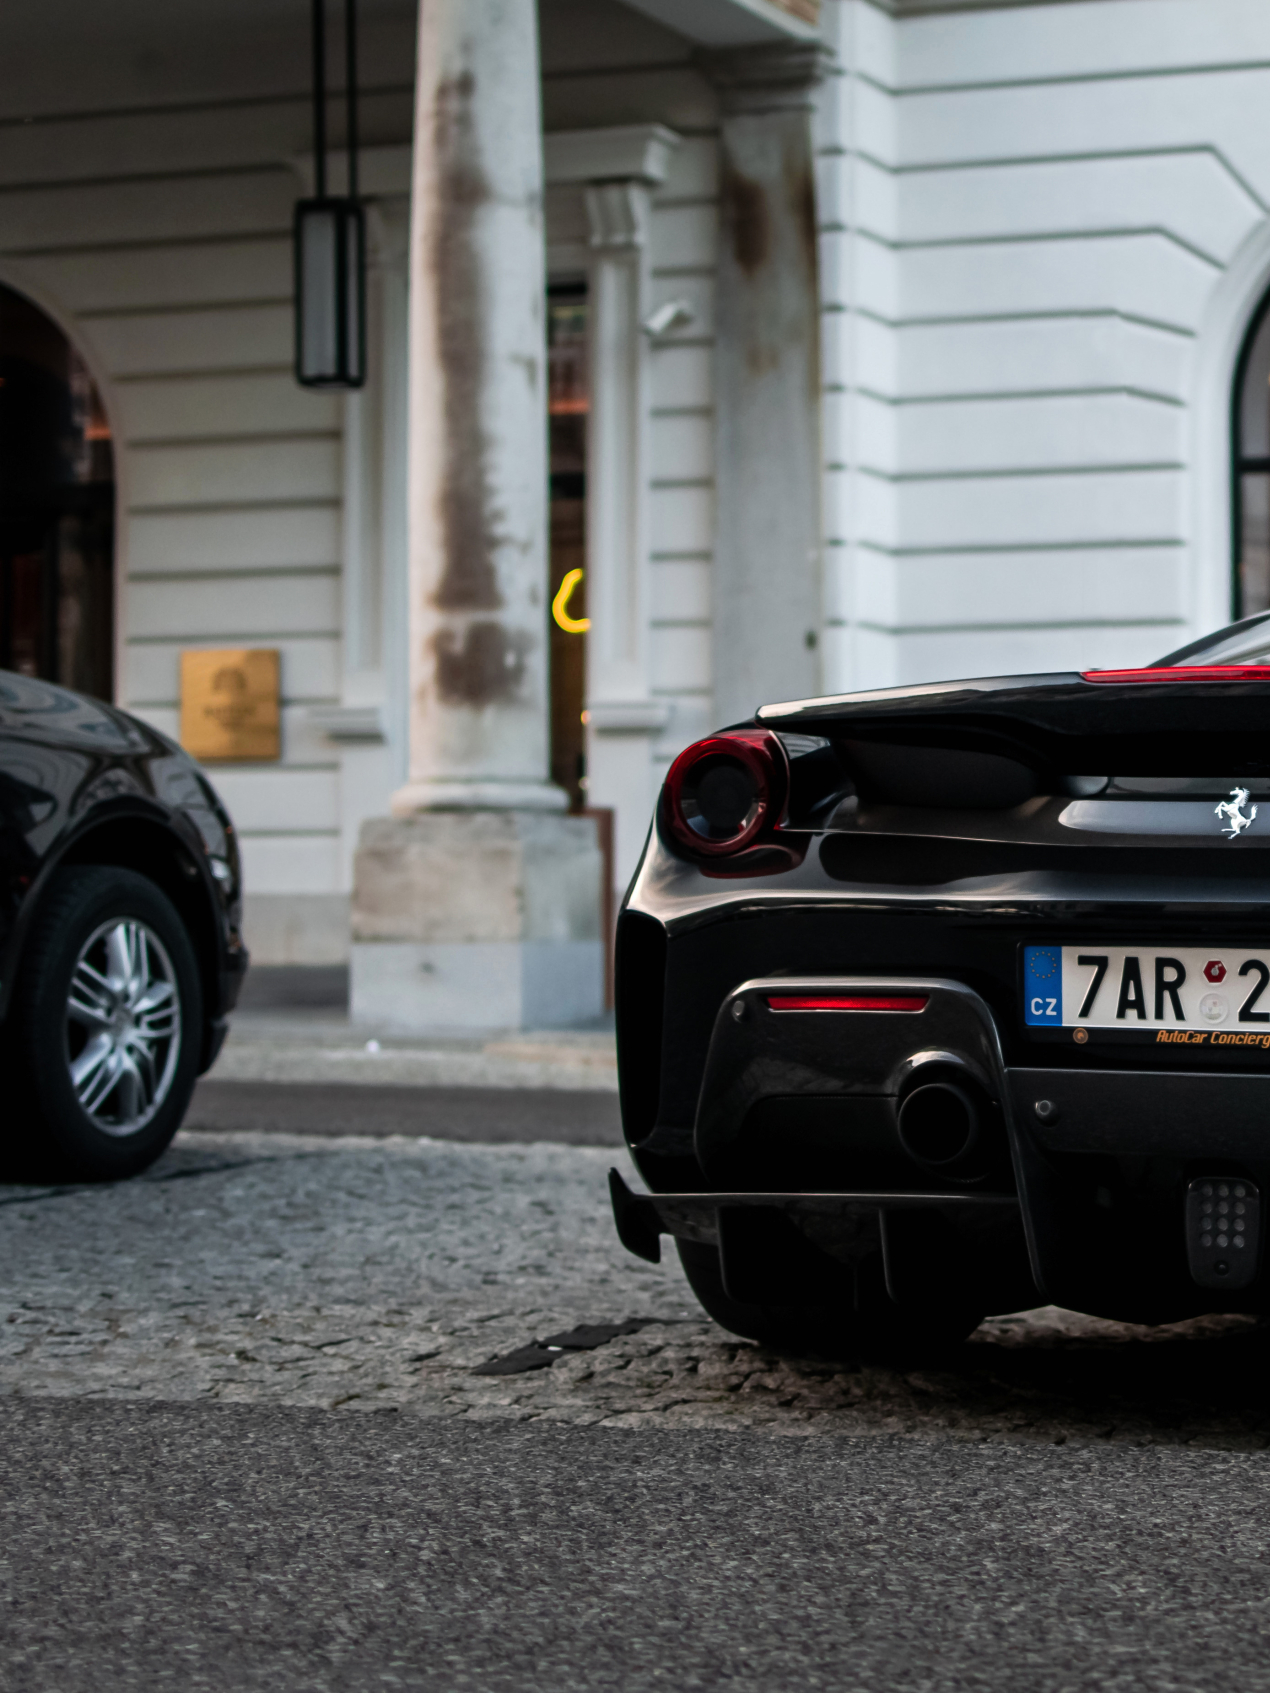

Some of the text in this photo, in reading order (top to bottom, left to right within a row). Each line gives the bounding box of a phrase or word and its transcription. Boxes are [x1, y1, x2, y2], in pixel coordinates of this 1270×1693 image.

[1077, 955, 1186, 1021] 7AR
[1030, 997, 1057, 1016] CZ
[1156, 1030, 1208, 1044] AutoCar
